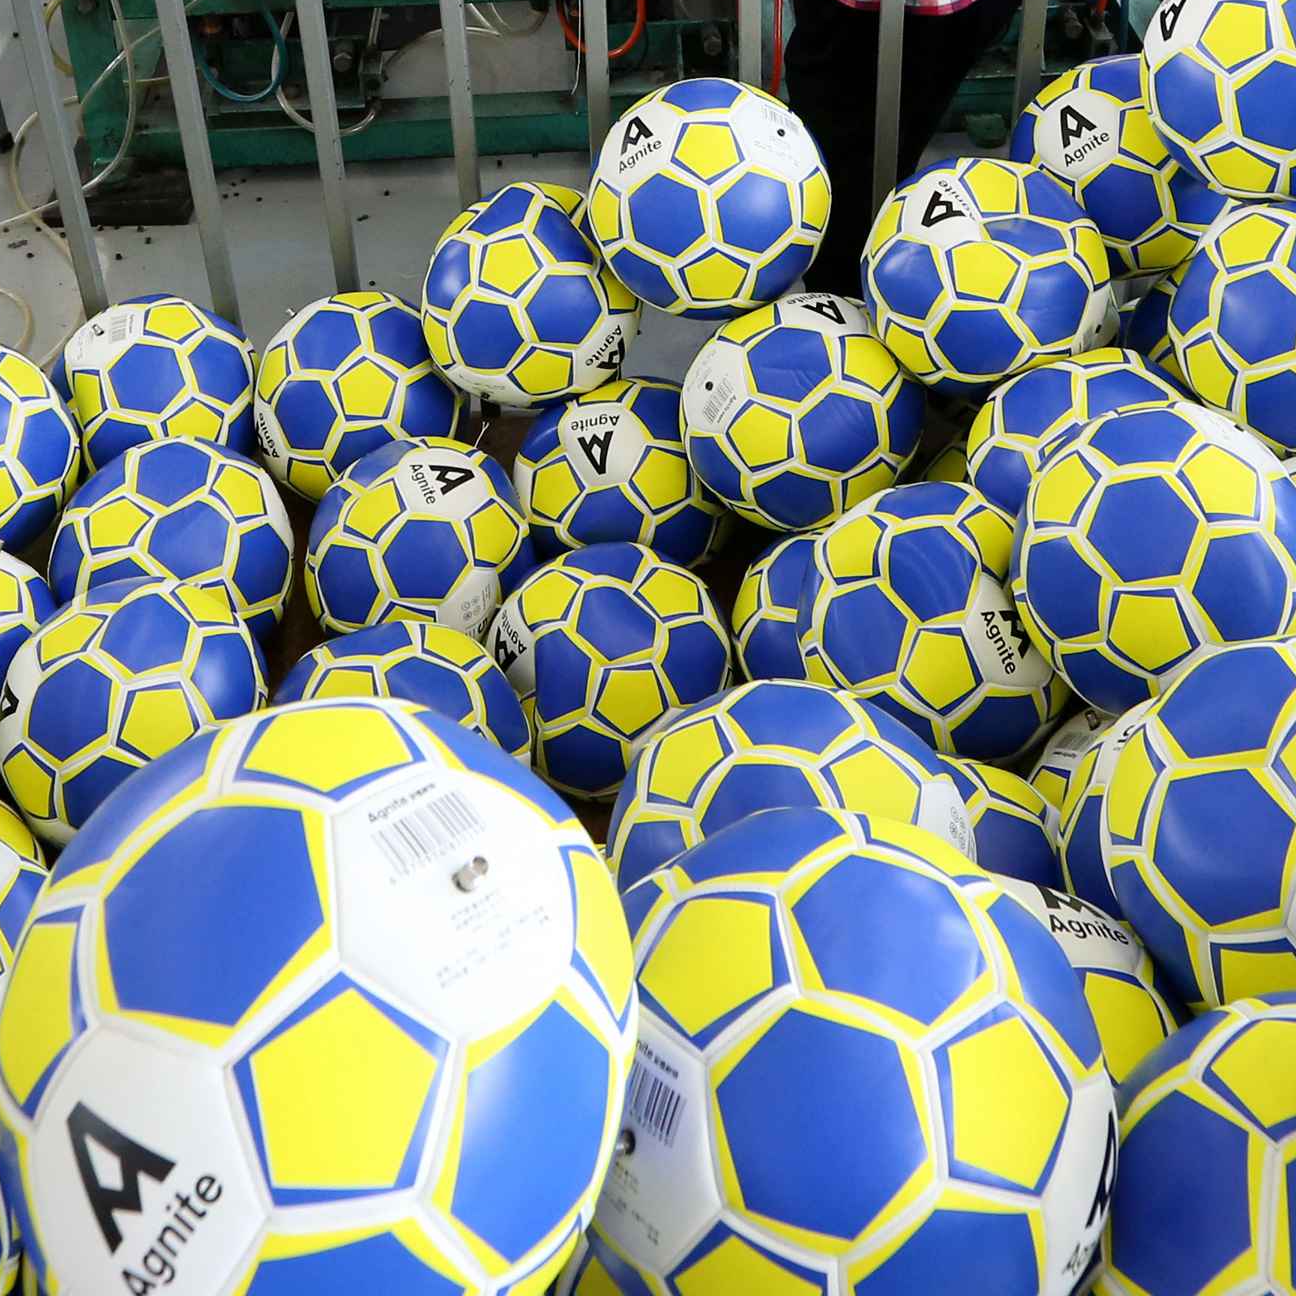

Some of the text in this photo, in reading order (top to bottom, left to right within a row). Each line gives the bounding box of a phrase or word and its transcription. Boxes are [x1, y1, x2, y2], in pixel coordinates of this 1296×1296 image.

[618, 139, 662, 175] Agnite
[1063, 129, 1110, 167] Agnite
[585, 325, 623, 369] Agnite
[570, 413, 621, 434] Agnite
[409, 463, 437, 506] Agnite
[981, 610, 1016, 675] Agnite
[1050, 914, 1129, 945] Agnite
[121, 1171, 224, 1296] Agnite
